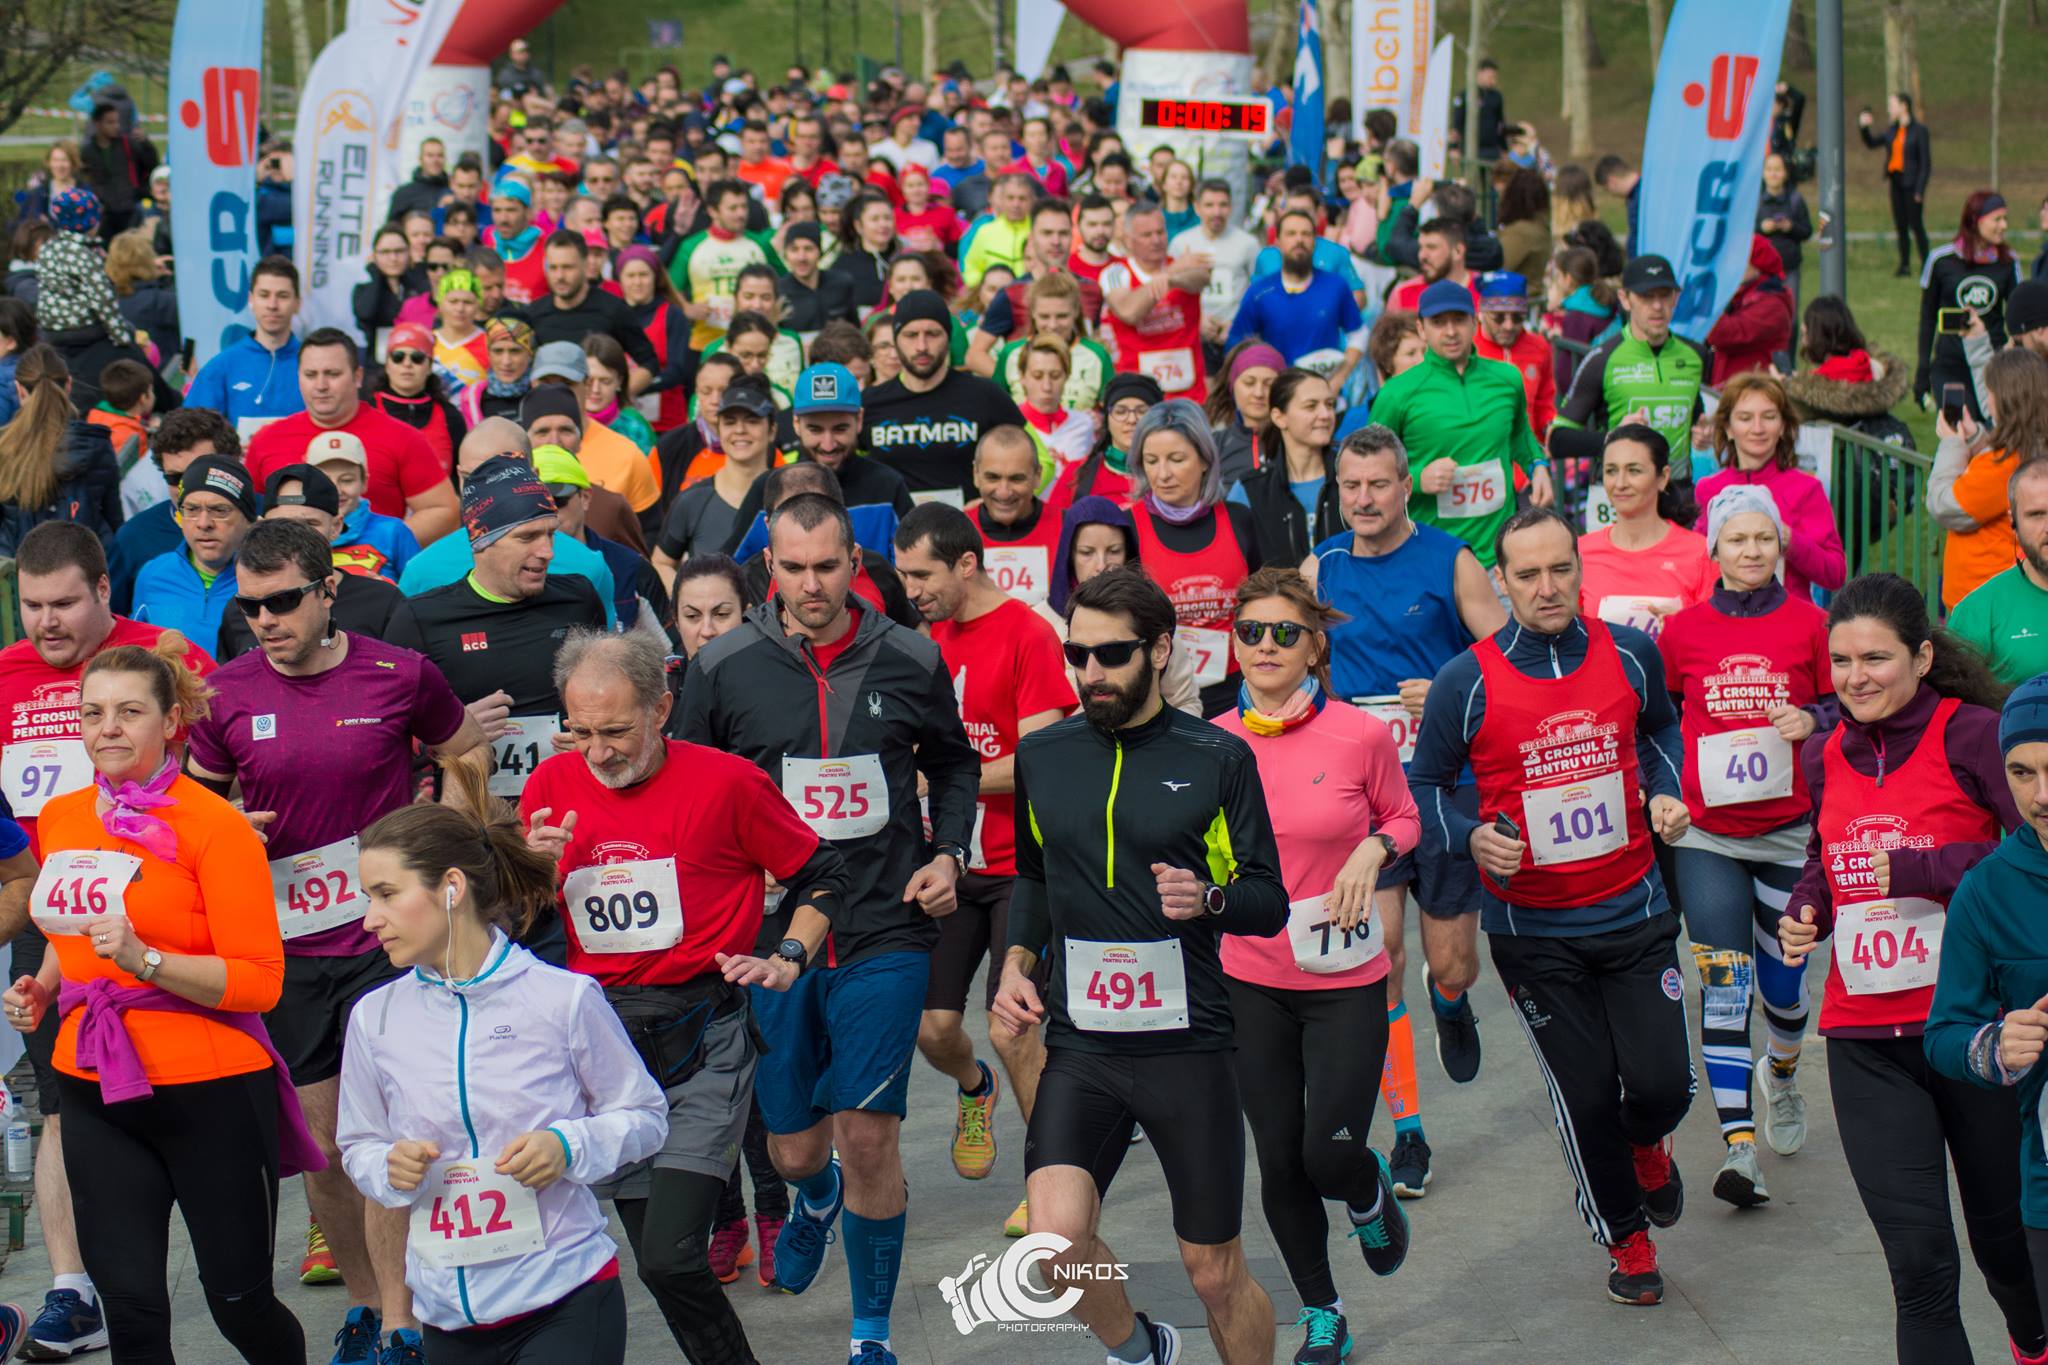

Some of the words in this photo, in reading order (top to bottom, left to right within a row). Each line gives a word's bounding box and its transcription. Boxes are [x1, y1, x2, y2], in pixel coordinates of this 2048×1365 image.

[337, 143, 367, 260] ELITE
[312, 159, 334, 289] RUNNING
[871, 422, 979, 447] BATMAN
[1452, 479, 1495, 506] 576
[984, 564, 1034, 592] 04
[463, 641, 488, 652] ACO
[1707, 699, 1755, 713] PENTRU
[1723, 686, 1772, 698] CROSUL
[13, 724, 64, 739] PENTRU
[32, 709, 82, 724] CROSUL
[1386, 718, 1421, 748] 05
[1544, 740, 1600, 761] CROSUL
[21, 765, 62, 798] 97
[1525, 757, 1581, 778] PENTRU
[1726, 751, 1769, 784] 40
[804, 782, 869, 819] 525
[1549, 801, 1614, 845] 101
[288, 869, 357, 915] 492
[1835, 872, 1878, 887] PENTR
[47, 877, 109, 915] 416
[584, 890, 659, 932] 809
[1852, 926, 1929, 971] 404
[1087, 970, 1163, 1010] 491
[429, 1189, 513, 1241] 412
